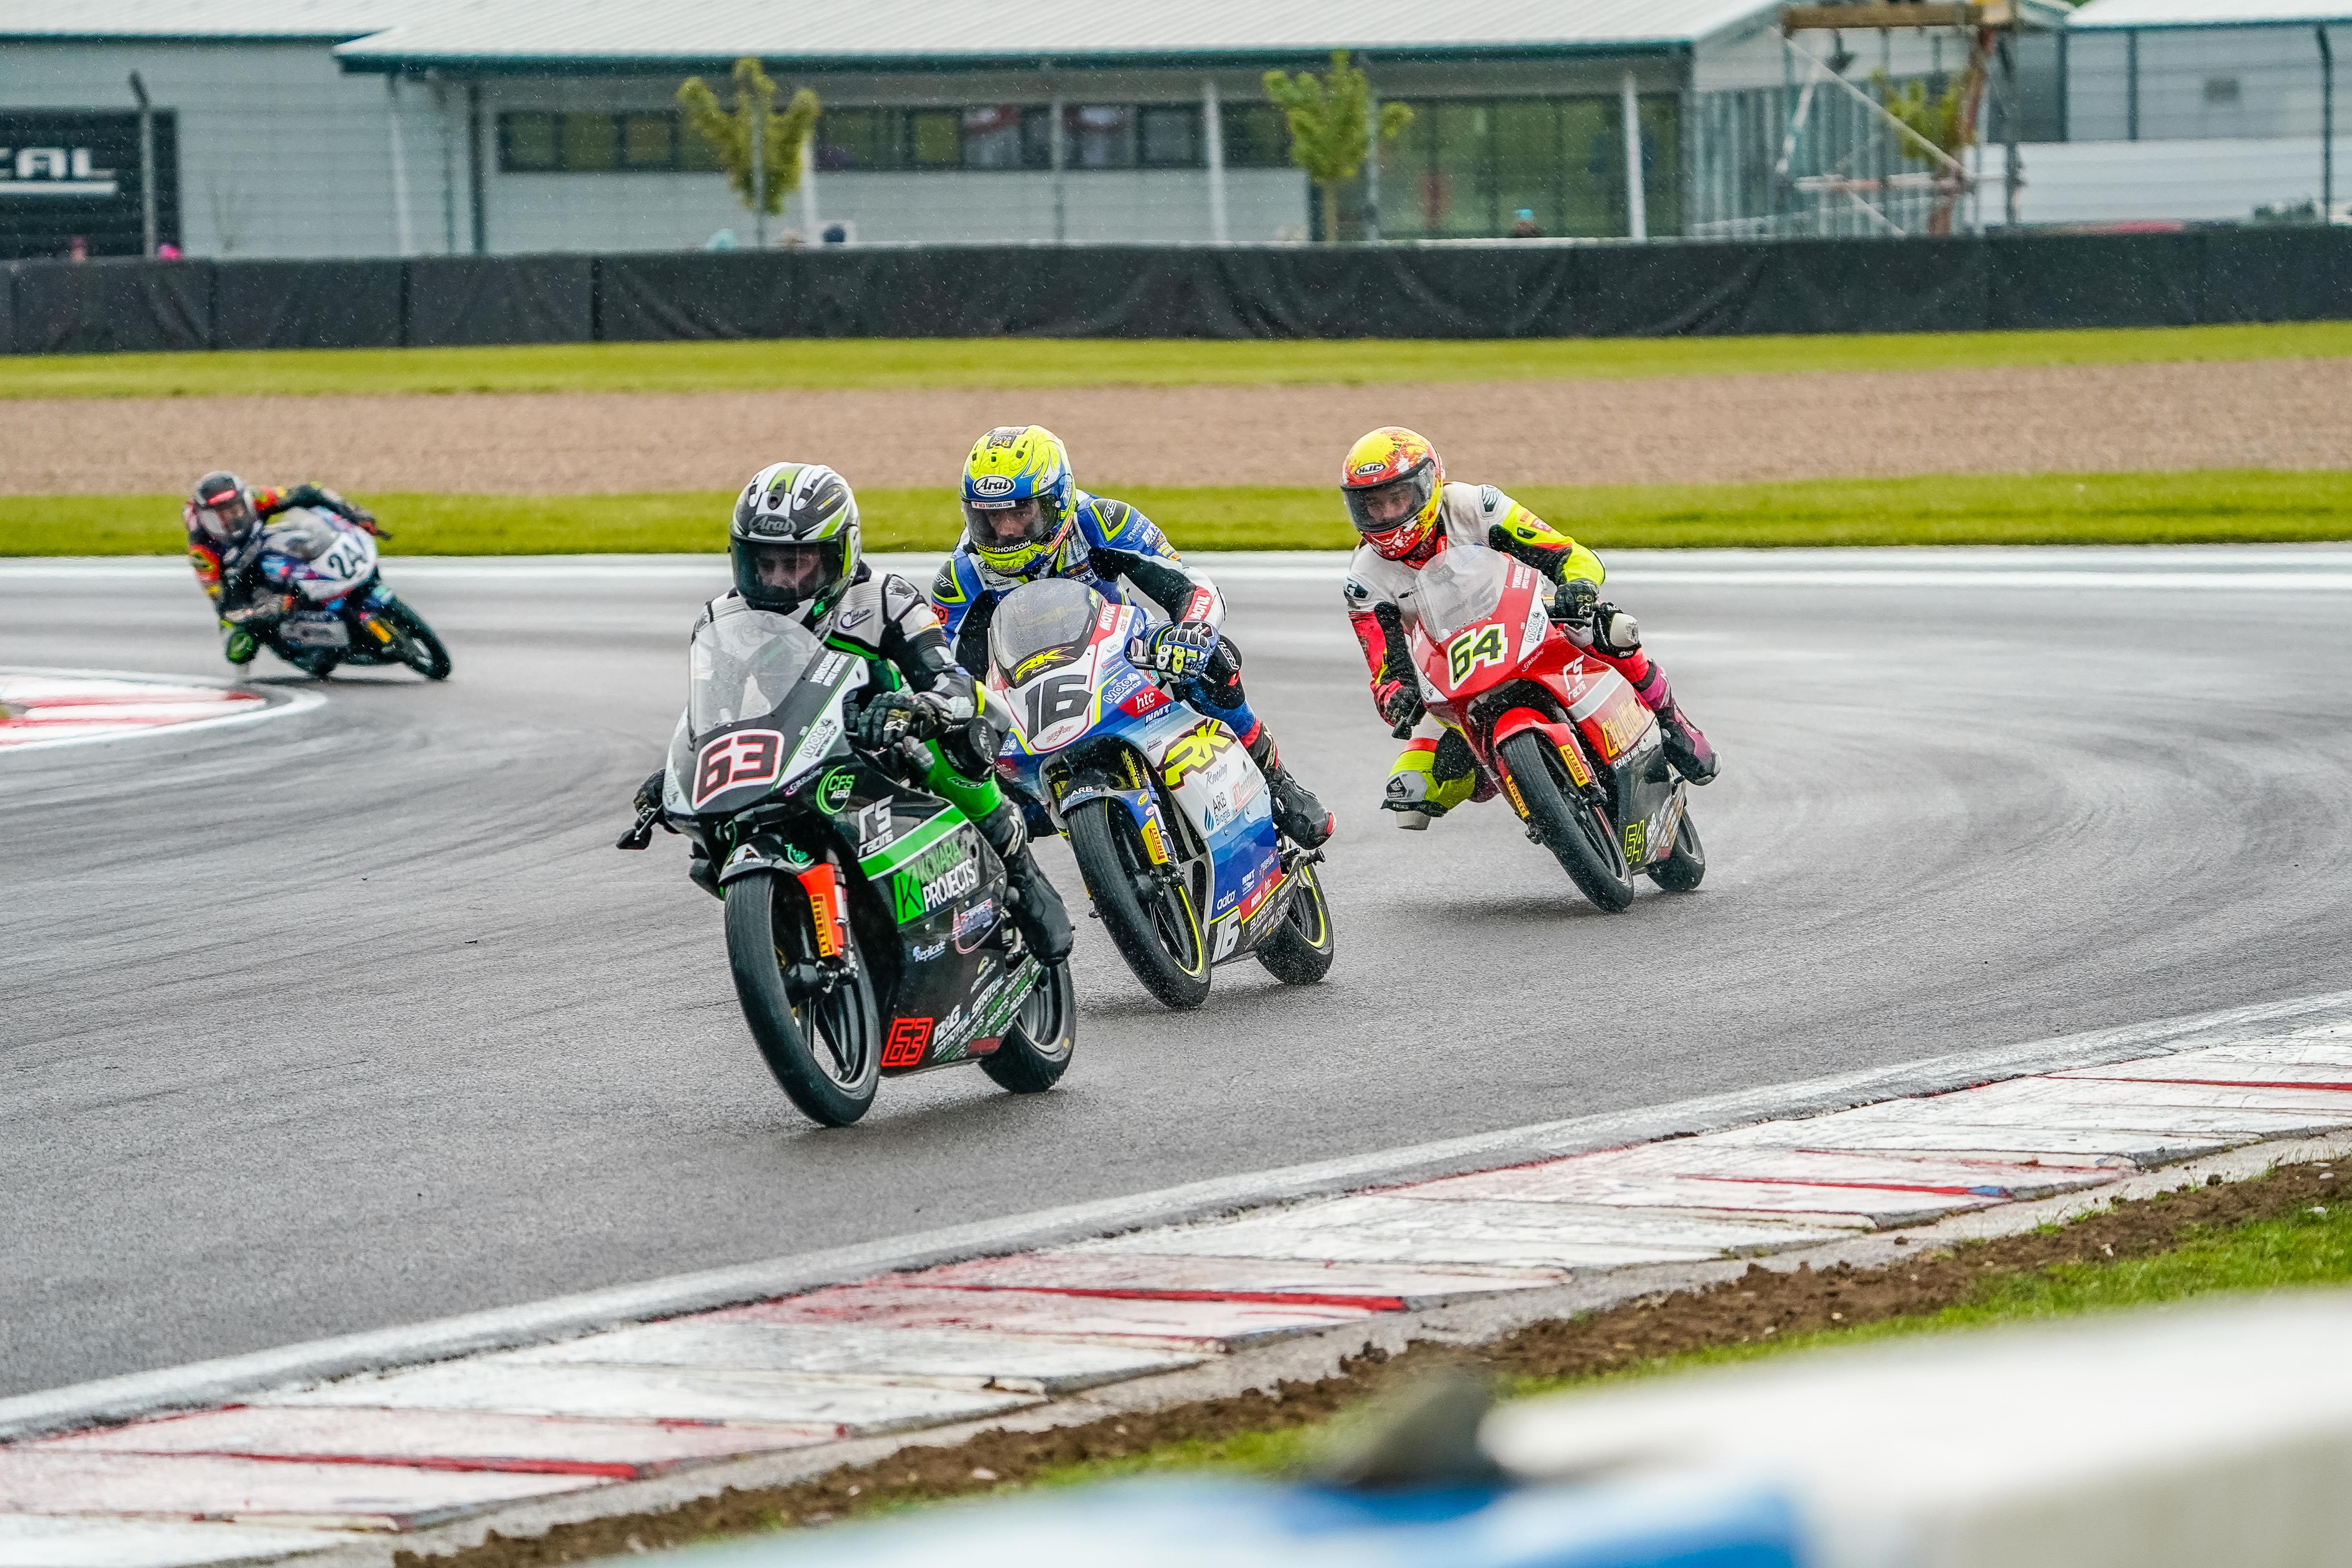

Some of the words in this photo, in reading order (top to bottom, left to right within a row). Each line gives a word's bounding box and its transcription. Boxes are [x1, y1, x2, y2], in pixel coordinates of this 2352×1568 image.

[976, 479, 1008, 490] Arai
[1358, 465, 1382, 474] HJC
[328, 542, 368, 579] 24
[935, 572, 954, 589] ST
[1511, 565, 1524, 588] YORKSHIRE
[1099, 602, 1116, 632] MOTUL
[1188, 595, 1211, 620] MOTUL
[1524, 611, 1542, 644] Moto4
[809, 650, 840, 684] YORKSHIRE
[1014, 648, 1077, 681] RK
[1450, 627, 1502, 684] 64
[1103, 673, 1140, 704] Moto4
[1134, 692, 1155, 710] htc
[1567, 681, 1587, 702] racing
[1025, 675, 1094, 745] 16
[1145, 703, 1171, 723] NMT
[800, 718, 834, 758] Moto4
[1164, 719, 1232, 786] RK
[696, 733, 779, 804] 63
[1205, 764, 1227, 788] Racing
[1564, 748, 1586, 783] PIRELLI
[827, 774, 855, 791] CFS
[1071, 786, 1093, 797] ARB
[1071, 792, 1094, 802] Biogas
[1213, 791, 1227, 814] ARB
[1215, 809, 1230, 826] Biogas
[858, 829, 894, 858] racing
[1148, 827, 1166, 861] PIRELLI
[1624, 819, 1645, 865] 64
[916, 837, 964, 885] KOVARA
[922, 858, 976, 913] PROJECTS
[1242, 868, 1255, 886] NMT
[1278, 871, 1299, 902] HONDA
[1216, 889, 1236, 910] adco
[1210, 908, 1240, 963] 16
[881, 1017, 933, 1067] 63
